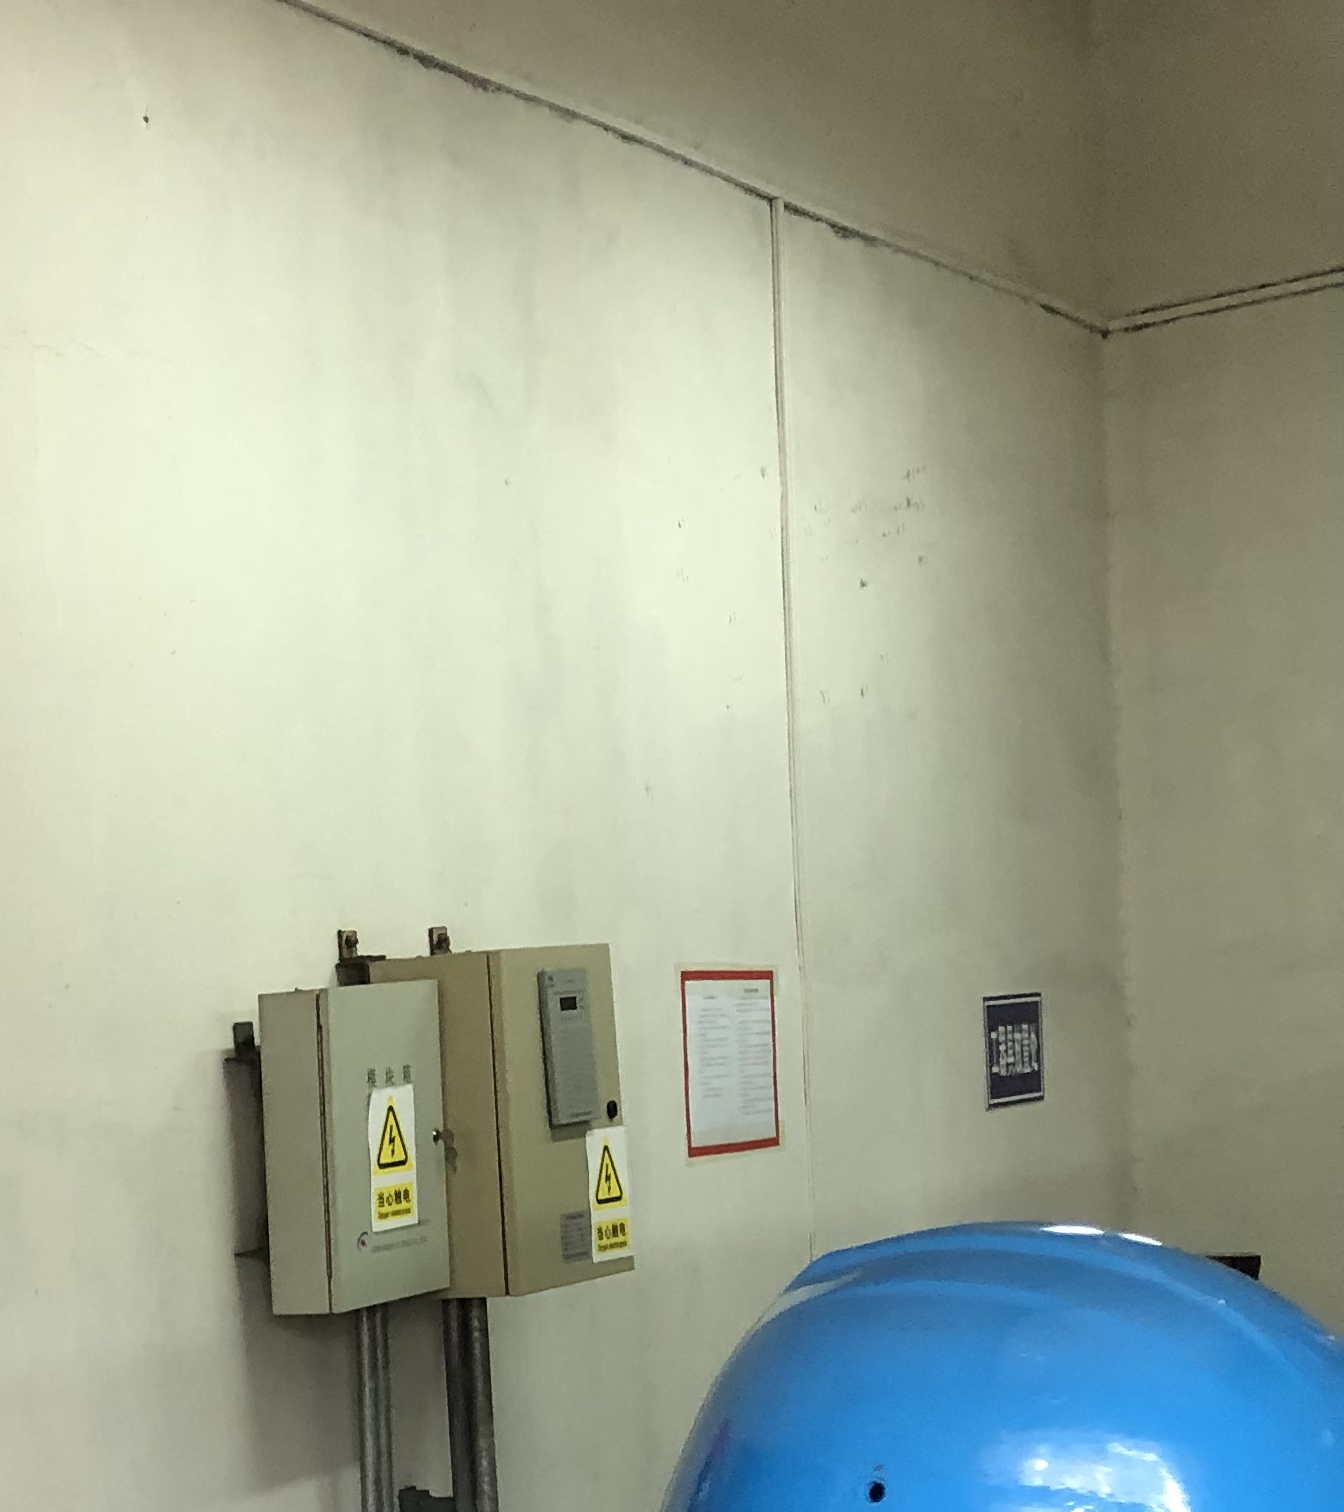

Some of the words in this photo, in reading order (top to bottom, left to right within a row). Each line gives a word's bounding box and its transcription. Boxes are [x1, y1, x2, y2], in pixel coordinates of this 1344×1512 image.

[377, 1187, 411, 1208] 当心触电
[596, 1221, 627, 1241] 当心触电
